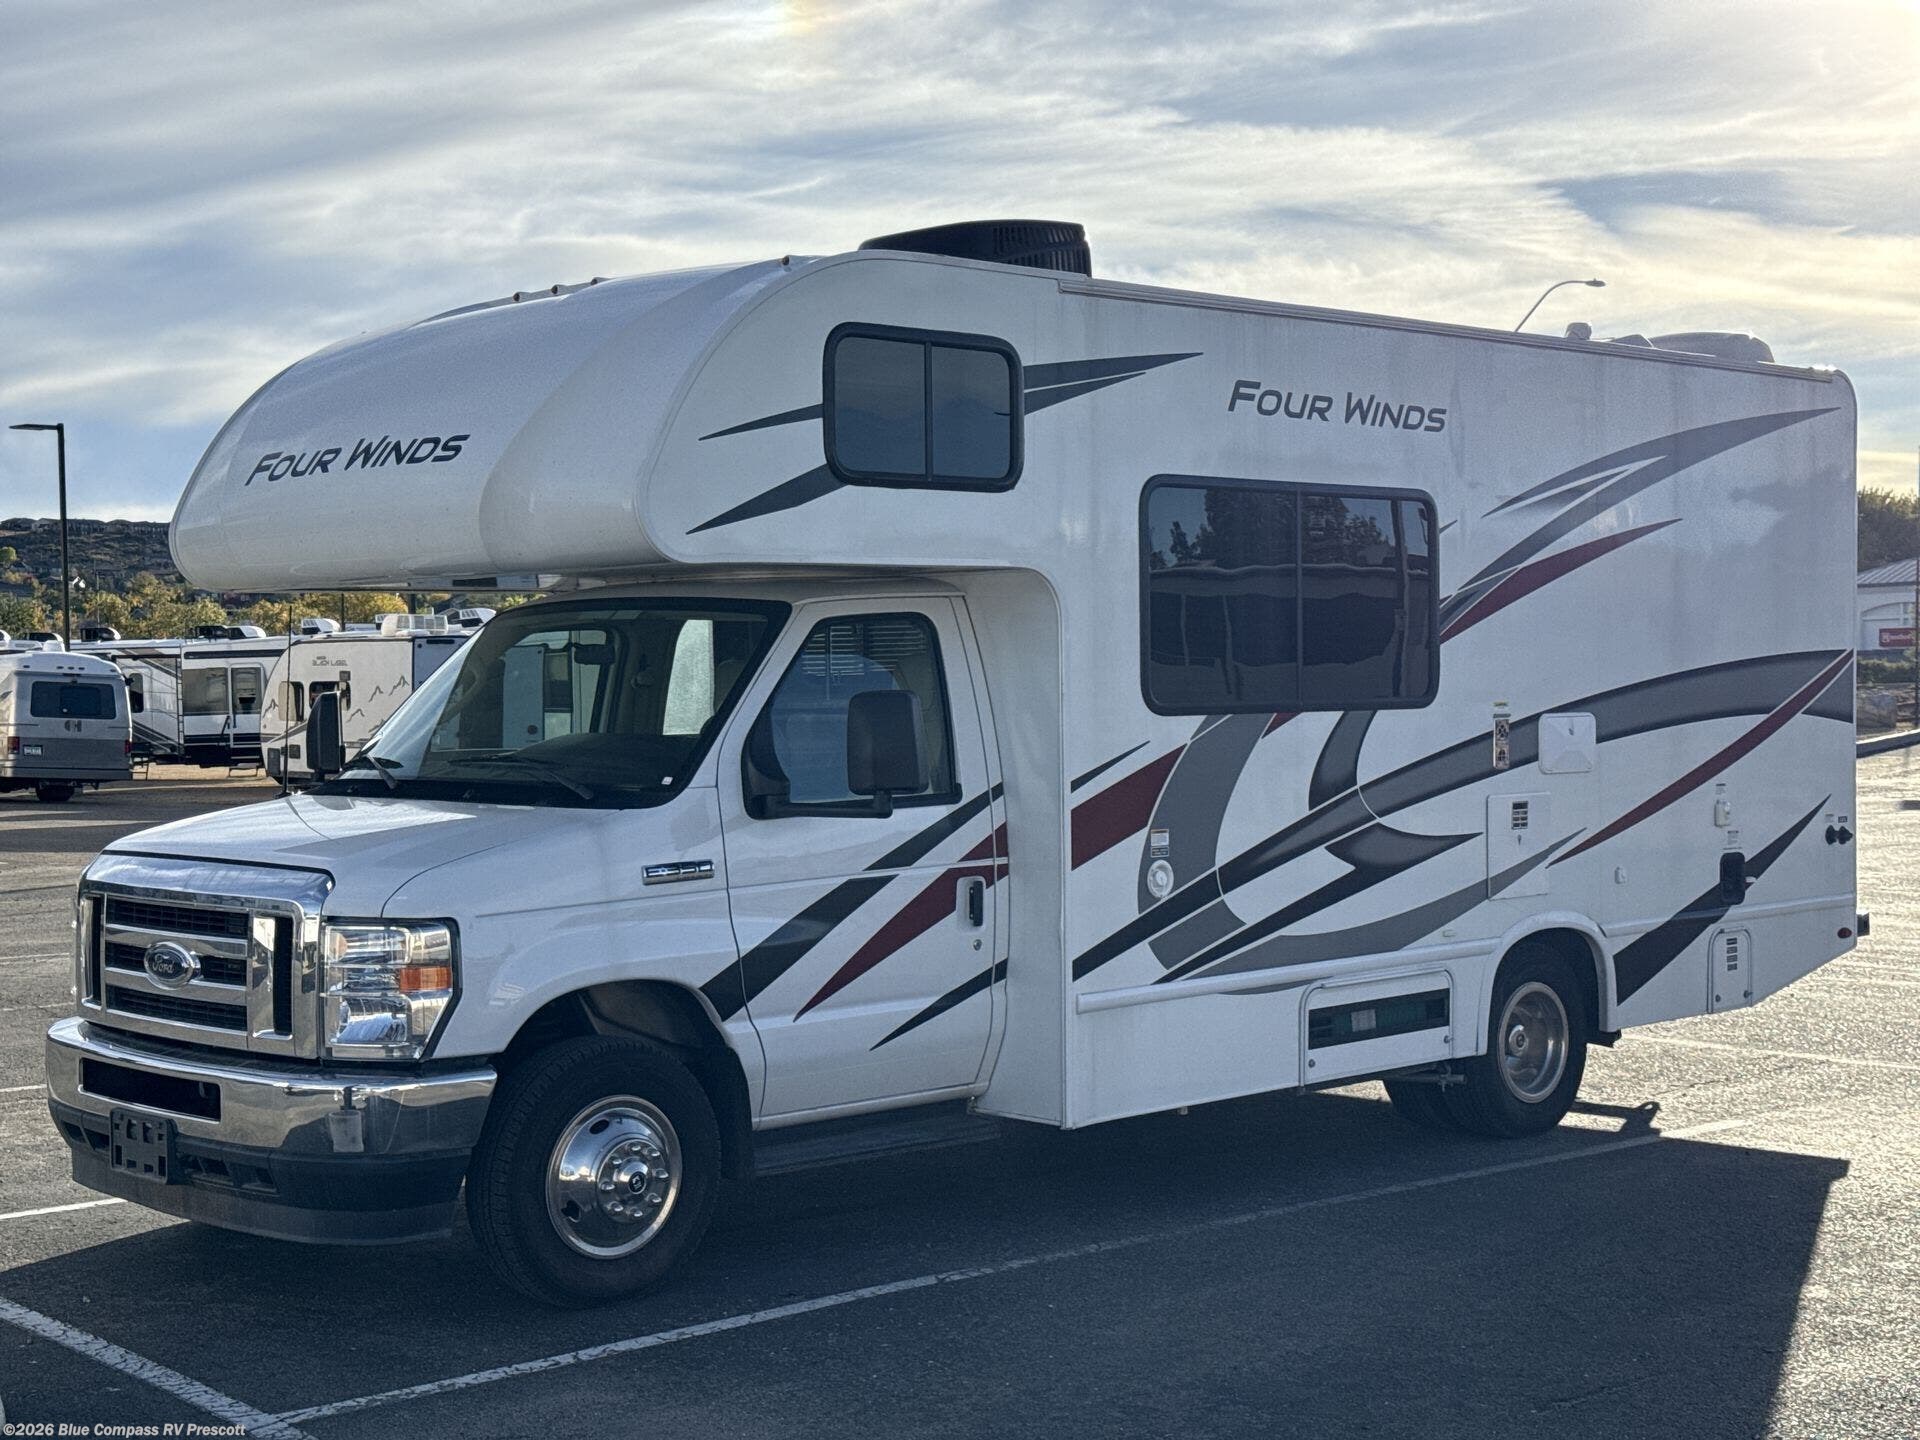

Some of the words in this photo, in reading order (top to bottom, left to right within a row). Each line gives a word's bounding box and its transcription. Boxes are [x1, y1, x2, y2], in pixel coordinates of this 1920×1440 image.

[1228, 379, 1333, 422] FOUR
[1344, 391, 1447, 433] WINDS
[245, 447, 343, 487] FOUR
[344, 434, 471, 472] WINDS
[152, 953, 176, 974] Ford
